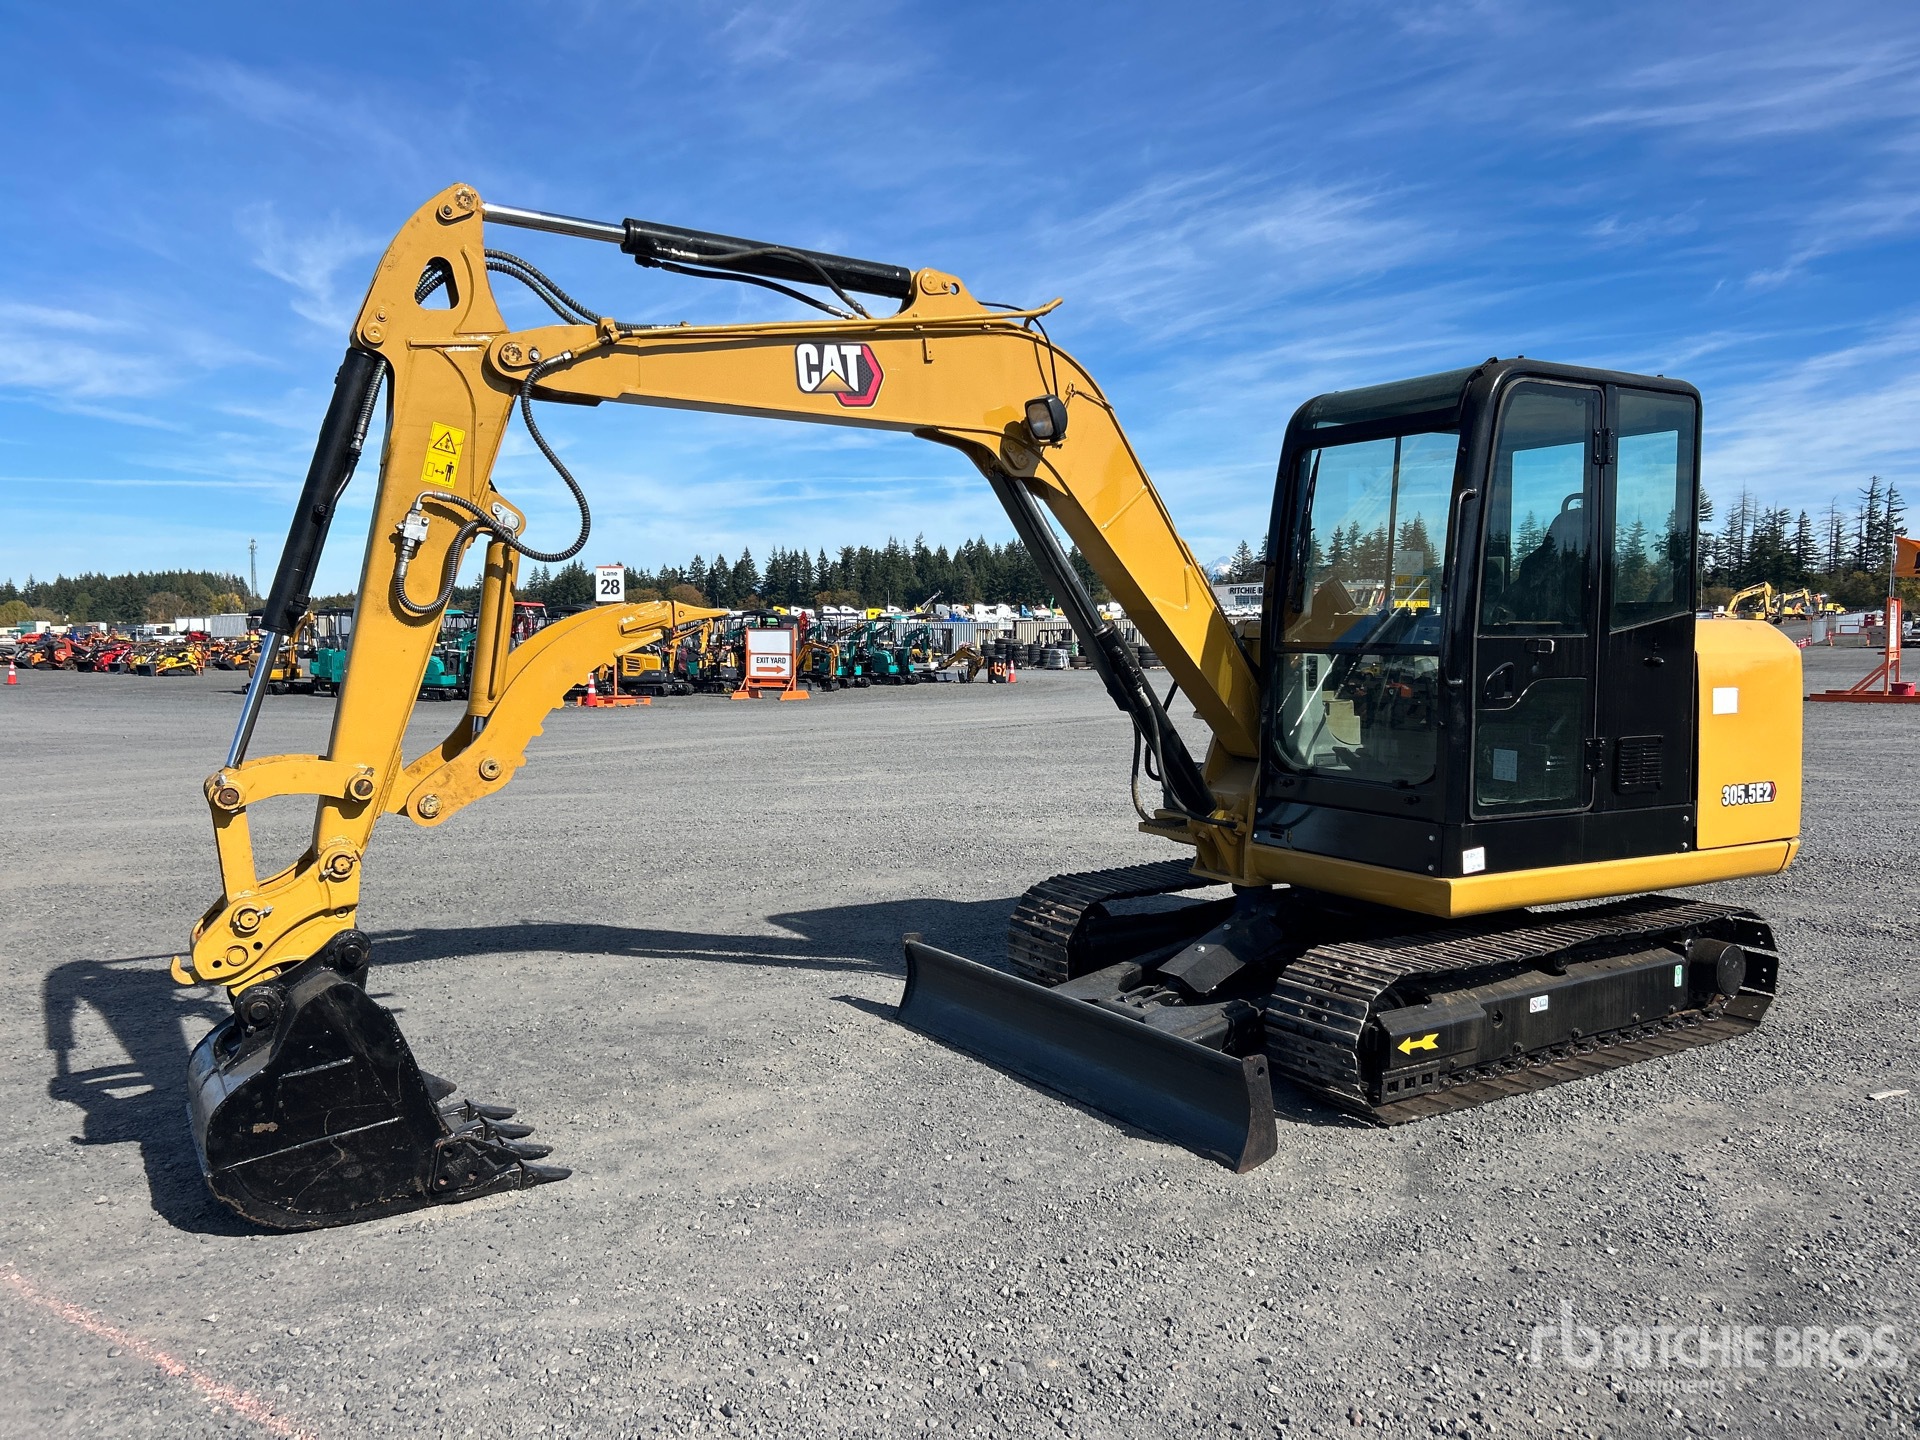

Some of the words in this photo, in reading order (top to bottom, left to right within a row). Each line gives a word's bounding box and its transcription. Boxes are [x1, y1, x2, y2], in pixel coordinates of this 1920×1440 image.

[796, 343, 862, 392] CAT
[600, 579, 620, 595] 28
[1229, 586, 1257, 594] RITCHIE
[756, 656, 770, 664] EXIT
[770, 656, 787, 664] YARD
[1721, 781, 1772, 806] 305.5E2
